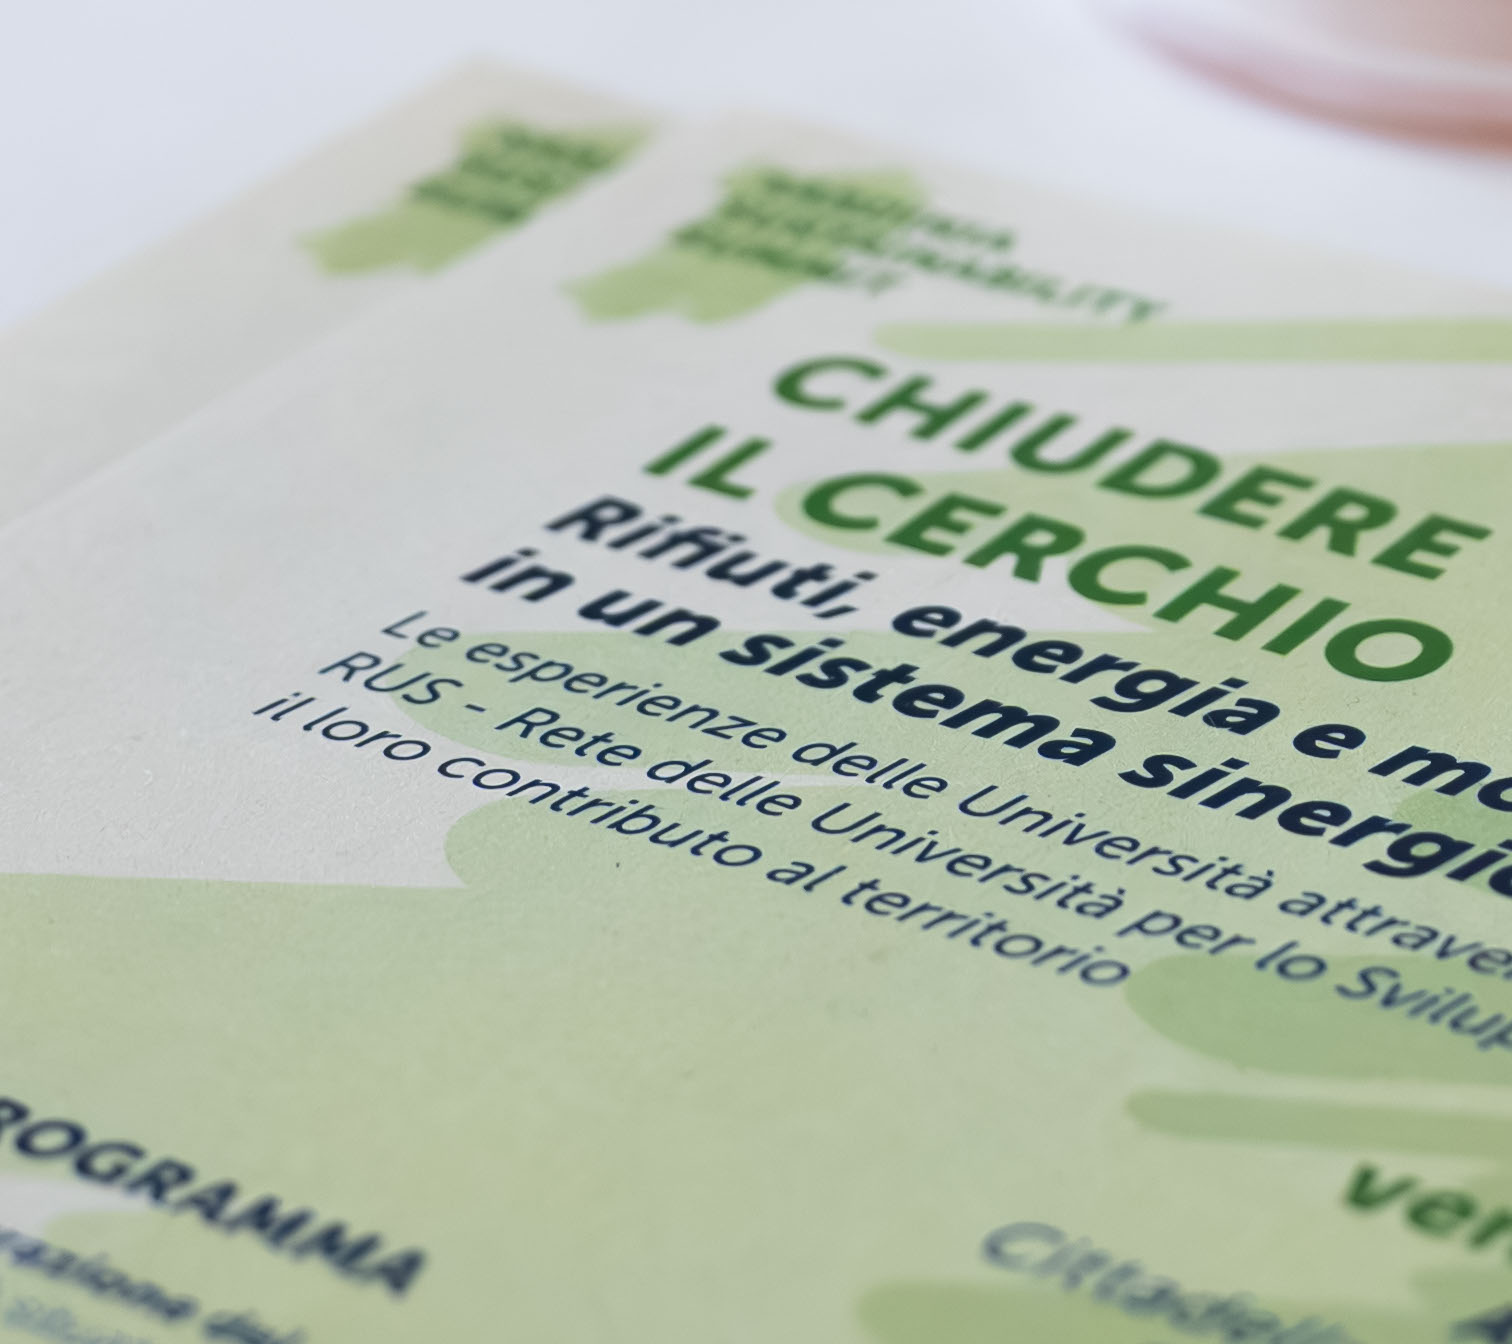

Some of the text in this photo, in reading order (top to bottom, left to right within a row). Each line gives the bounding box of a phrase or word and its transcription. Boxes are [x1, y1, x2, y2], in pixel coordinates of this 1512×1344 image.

[643, 423, 1455, 682] IL CERCHIO
[771, 354, 1494, 580] CHIUDERE
[380, 610, 461, 649] Le
[465, 637, 789, 751] esperienze
[791, 740, 949, 801] delle
[957, 784, 1276, 901] Università
[460, 549, 576, 606] in
[577, 587, 722, 648] un
[718, 631, 1117, 766] sistema
[544, 494, 878, 619] Rifiuti,
[890, 600, 1282, 737] energia
[1292, 722, 1368, 759] e
[252, 691, 1132, 988] il loro contributo al territorio
[317, 650, 465, 709] RUS
[493, 706, 643, 768] Rete
[645, 757, 803, 818] delle
[810, 802, 1127, 920] Università
[1115, 908, 1256, 955] per
[1253, 941, 1329, 982] lo
